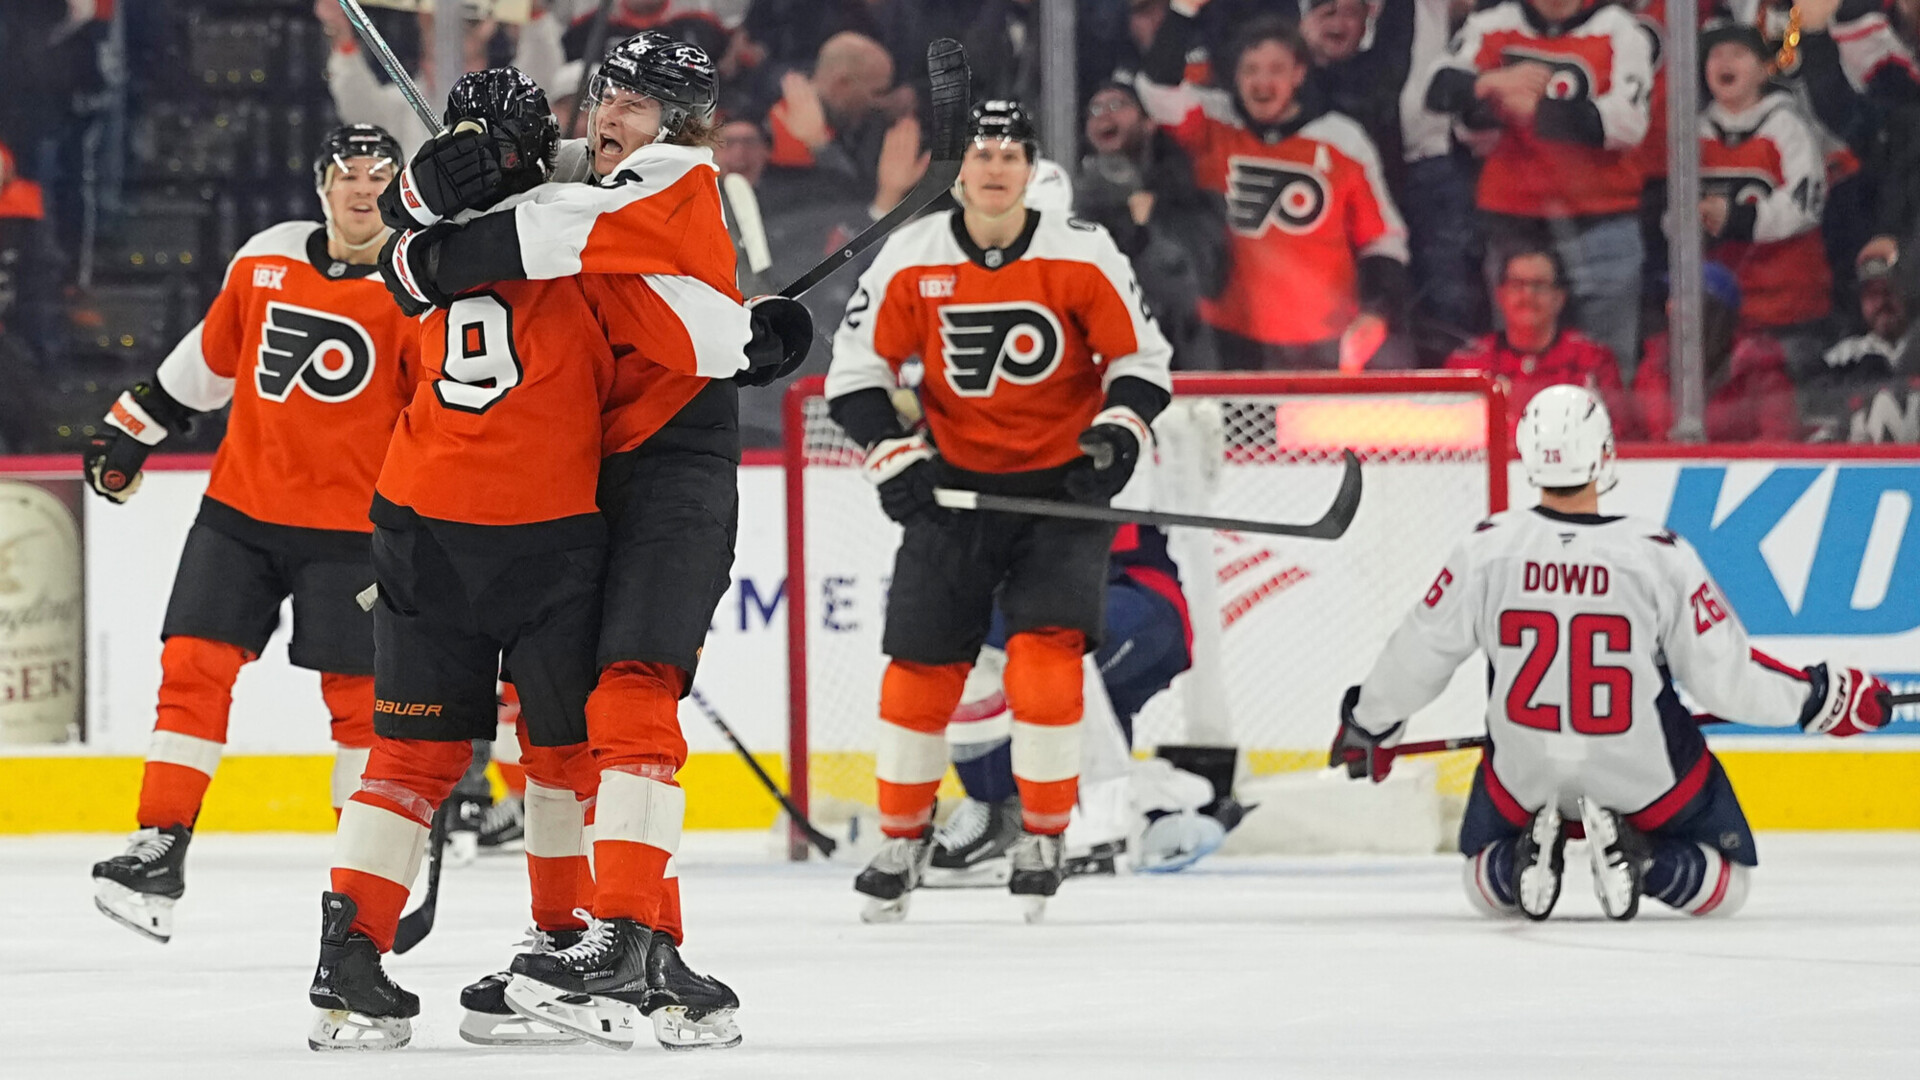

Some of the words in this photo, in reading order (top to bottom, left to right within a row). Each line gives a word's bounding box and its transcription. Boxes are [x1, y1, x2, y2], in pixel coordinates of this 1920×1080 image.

[432, 289, 524, 416] 9
[1523, 561, 1610, 596] DOWD
[1690, 582, 1727, 636] 26
[1499, 609, 1633, 735] 26
[374, 699, 443, 718] BAUER
